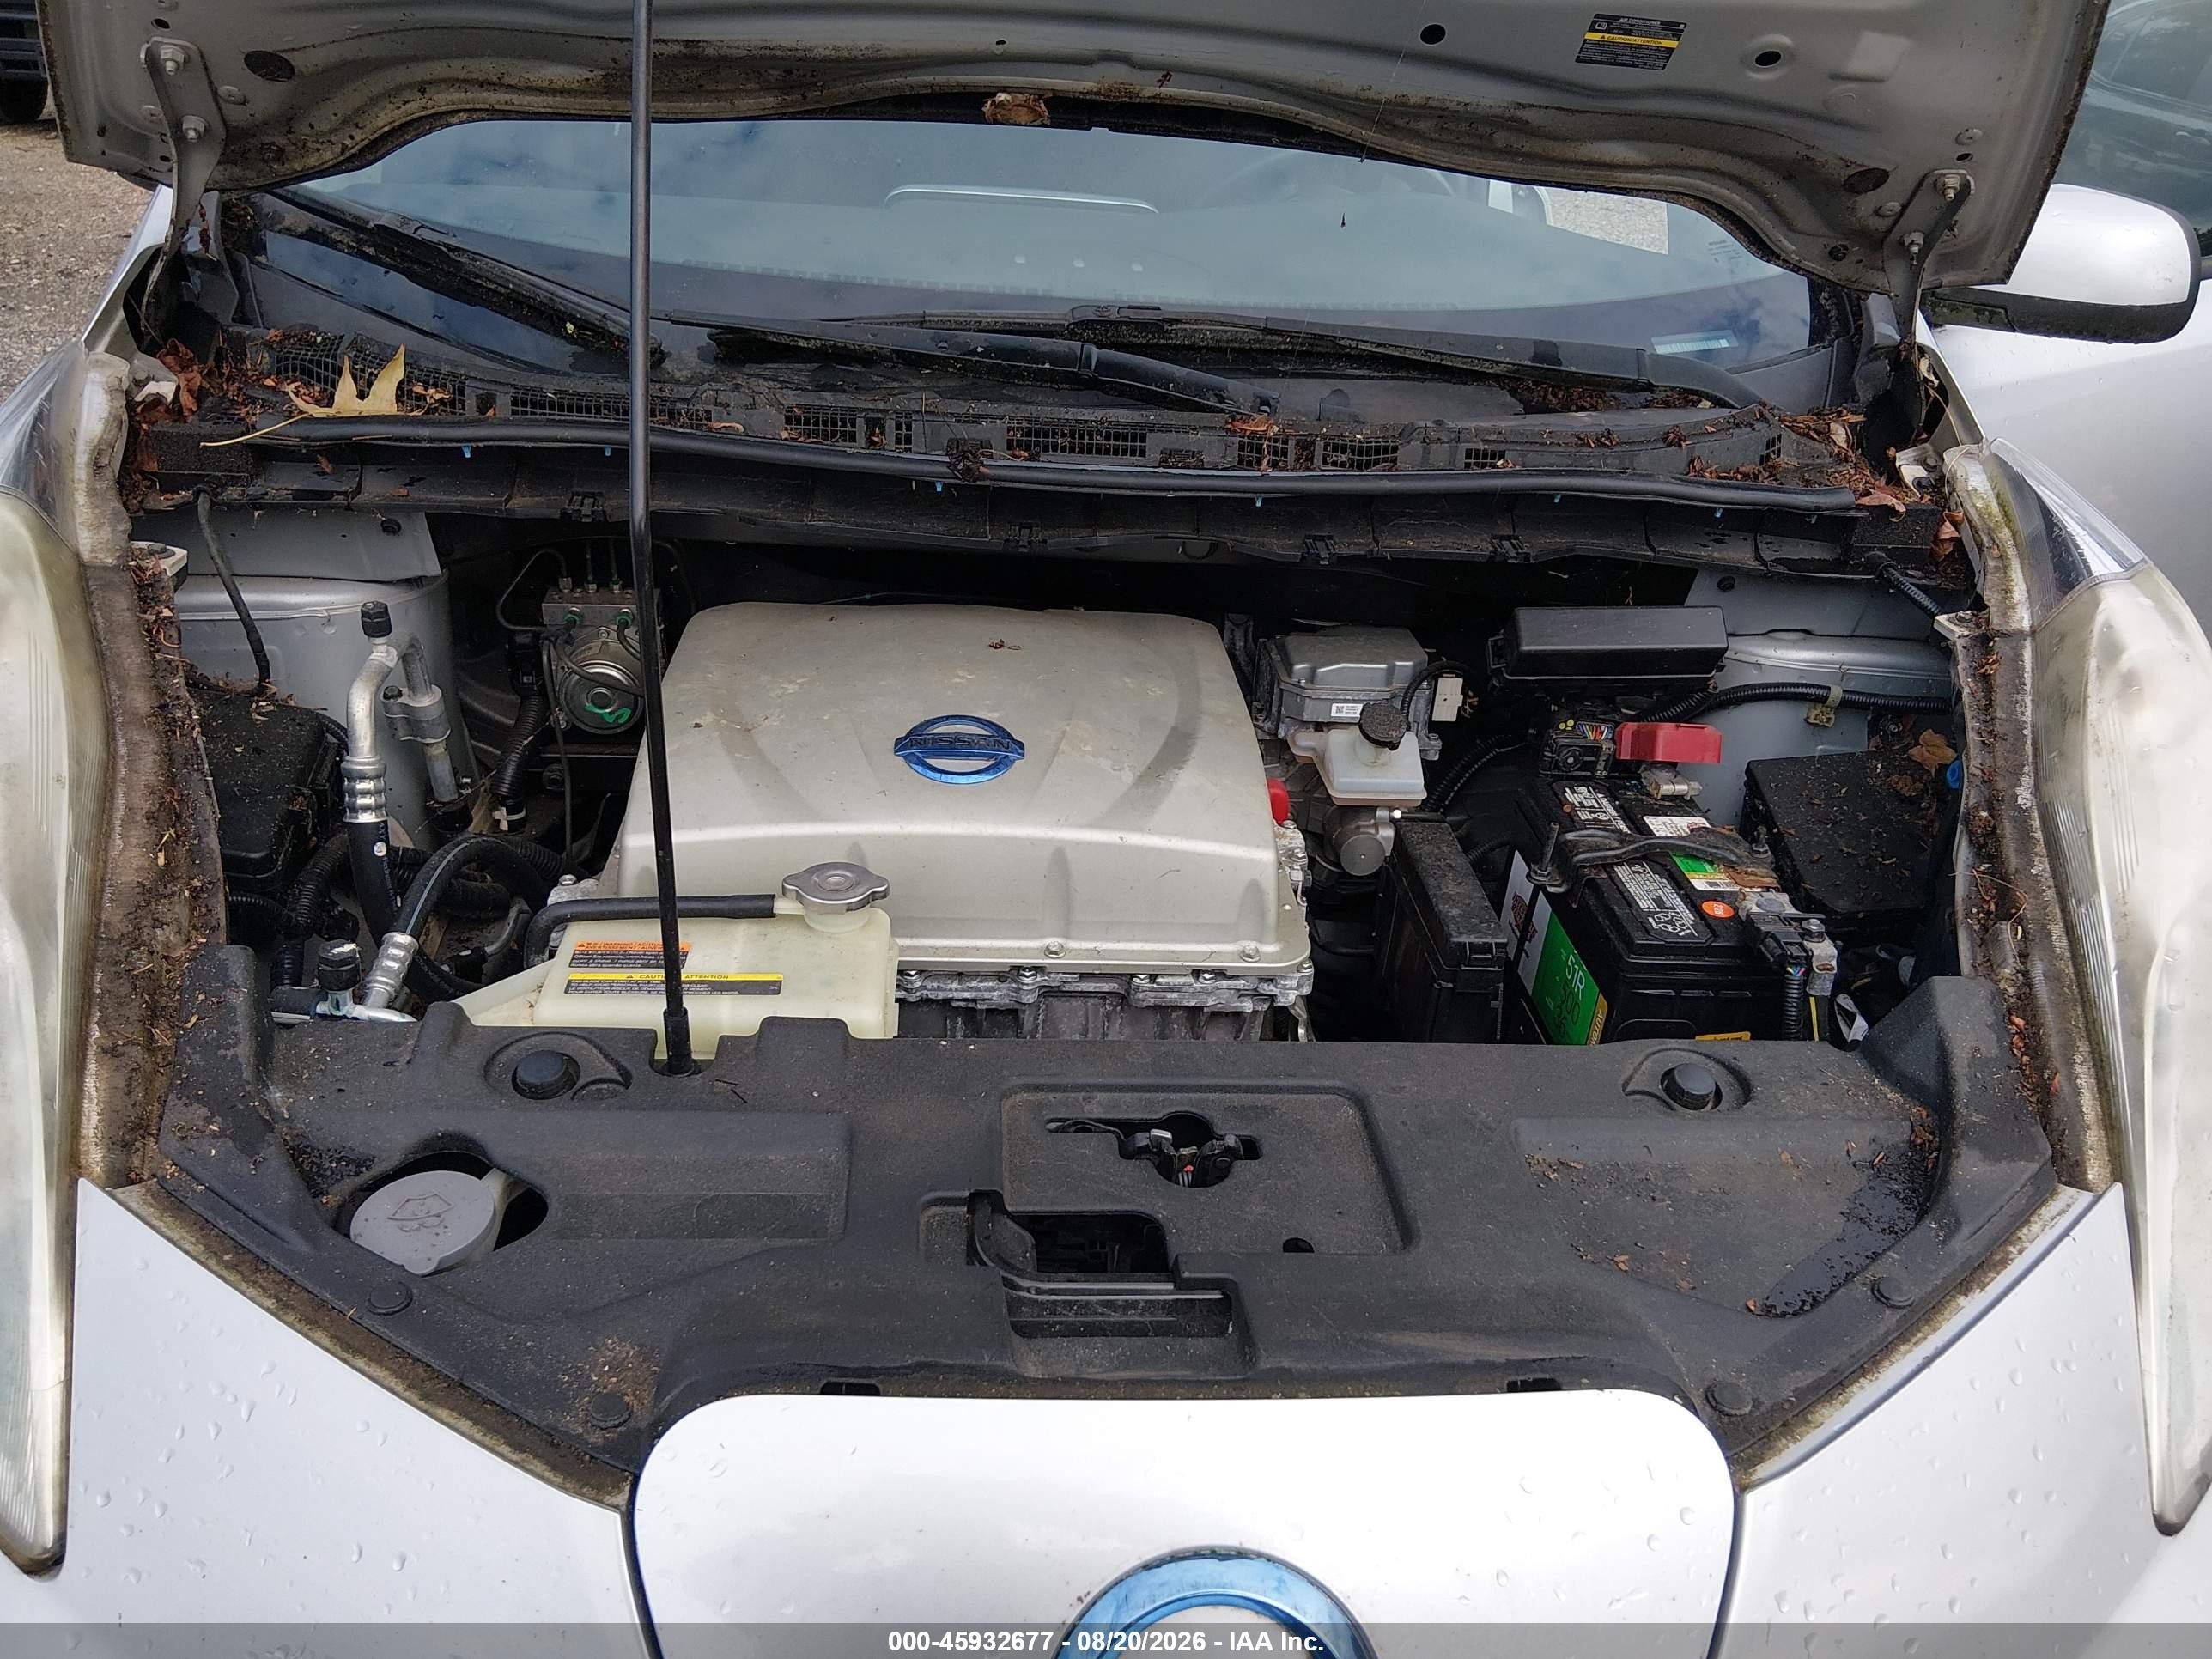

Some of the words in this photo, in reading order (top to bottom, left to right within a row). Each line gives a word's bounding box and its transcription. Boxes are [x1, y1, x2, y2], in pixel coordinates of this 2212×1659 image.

[1607, 35, 1663, 46] CAUTION/ATTENTION
[908, 736, 1011, 750] NISSAN
[1565, 954, 1585, 1000] 51R
